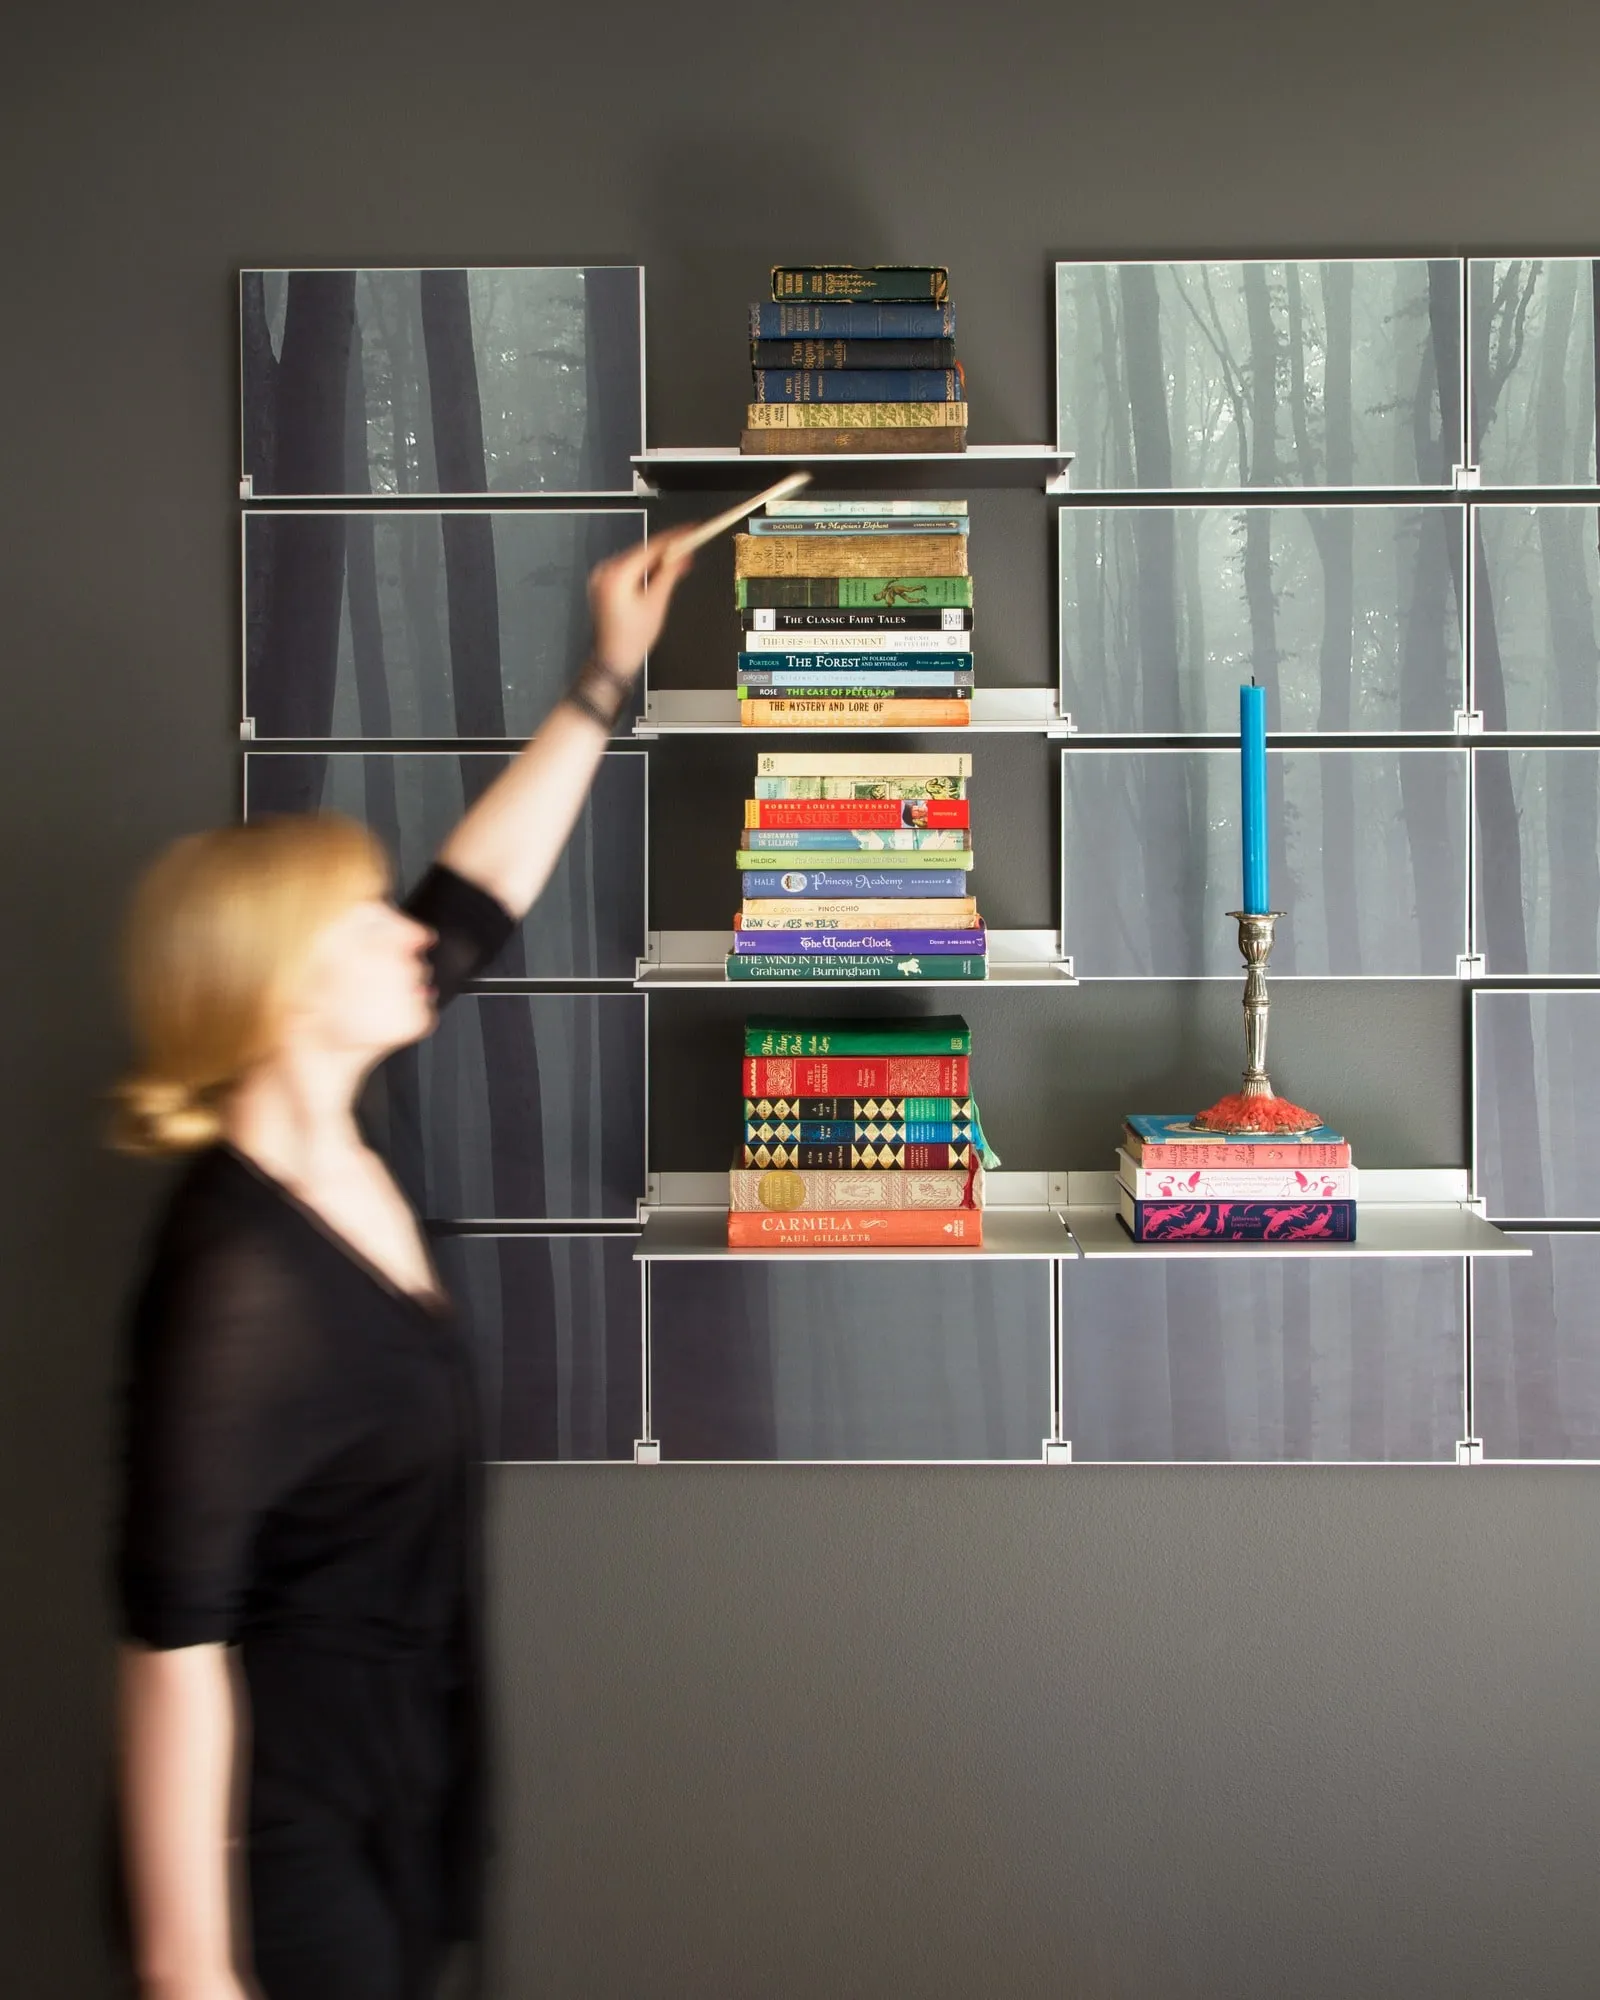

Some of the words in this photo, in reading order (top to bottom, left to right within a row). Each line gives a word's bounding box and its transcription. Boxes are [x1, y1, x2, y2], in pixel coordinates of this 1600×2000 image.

[785, 376, 793, 395] OUR
[794, 371, 802, 402] MUTUAL
[803, 372, 811, 402] FRIEND
[814, 522, 828, 530] The
[827, 522, 862, 530] Magician's
[863, 521, 889, 530] Elephant
[783, 615, 804, 624] THE
[806, 615, 847, 624] CLASSIC
[849, 615, 875, 624] FAIRY
[878, 615, 907, 624] TALES
[814, 637, 884, 646] ENCHANTMENT
[785, 655, 812, 668] THE
[815, 655, 861, 668] FOREST
[759, 688, 778, 696] ROSE
[786, 688, 805, 696] THE
[806, 688, 829, 696] CASE
[845, 689, 873, 697] PETER
[875, 689, 895, 697] PAN
[768, 701, 786, 712] THE
[788, 701, 827, 712] MYSTERY
[828, 701, 845, 712] AND
[848, 701, 871, 712] LORE
[873, 701, 886, 712] OF
[767, 812, 840, 825] TREASURE
[847, 812, 900, 825] ISLAND
[767, 839, 799, 847] LILLIPUT
[754, 878, 775, 886] HALE
[811, 871, 853, 890] Princess
[855, 874, 903, 890] Academy
[800, 937, 822, 951] The
[822, 936, 861, 951] Wonder
[861, 936, 892, 949] Clock
[738, 955, 763, 965] THE
[764, 955, 797, 965] WIND
[798, 955, 811, 965] IN
[812, 955, 838, 965] THE
[838, 955, 894, 965] WILLOWS
[750, 966, 801, 977] Grahame
[812, 966, 881, 978] Burningham
[762, 1217, 853, 1231] CARMELA
[780, 1234, 809, 1242] PAUL
[814, 1233, 871, 1242] GILLETTE
